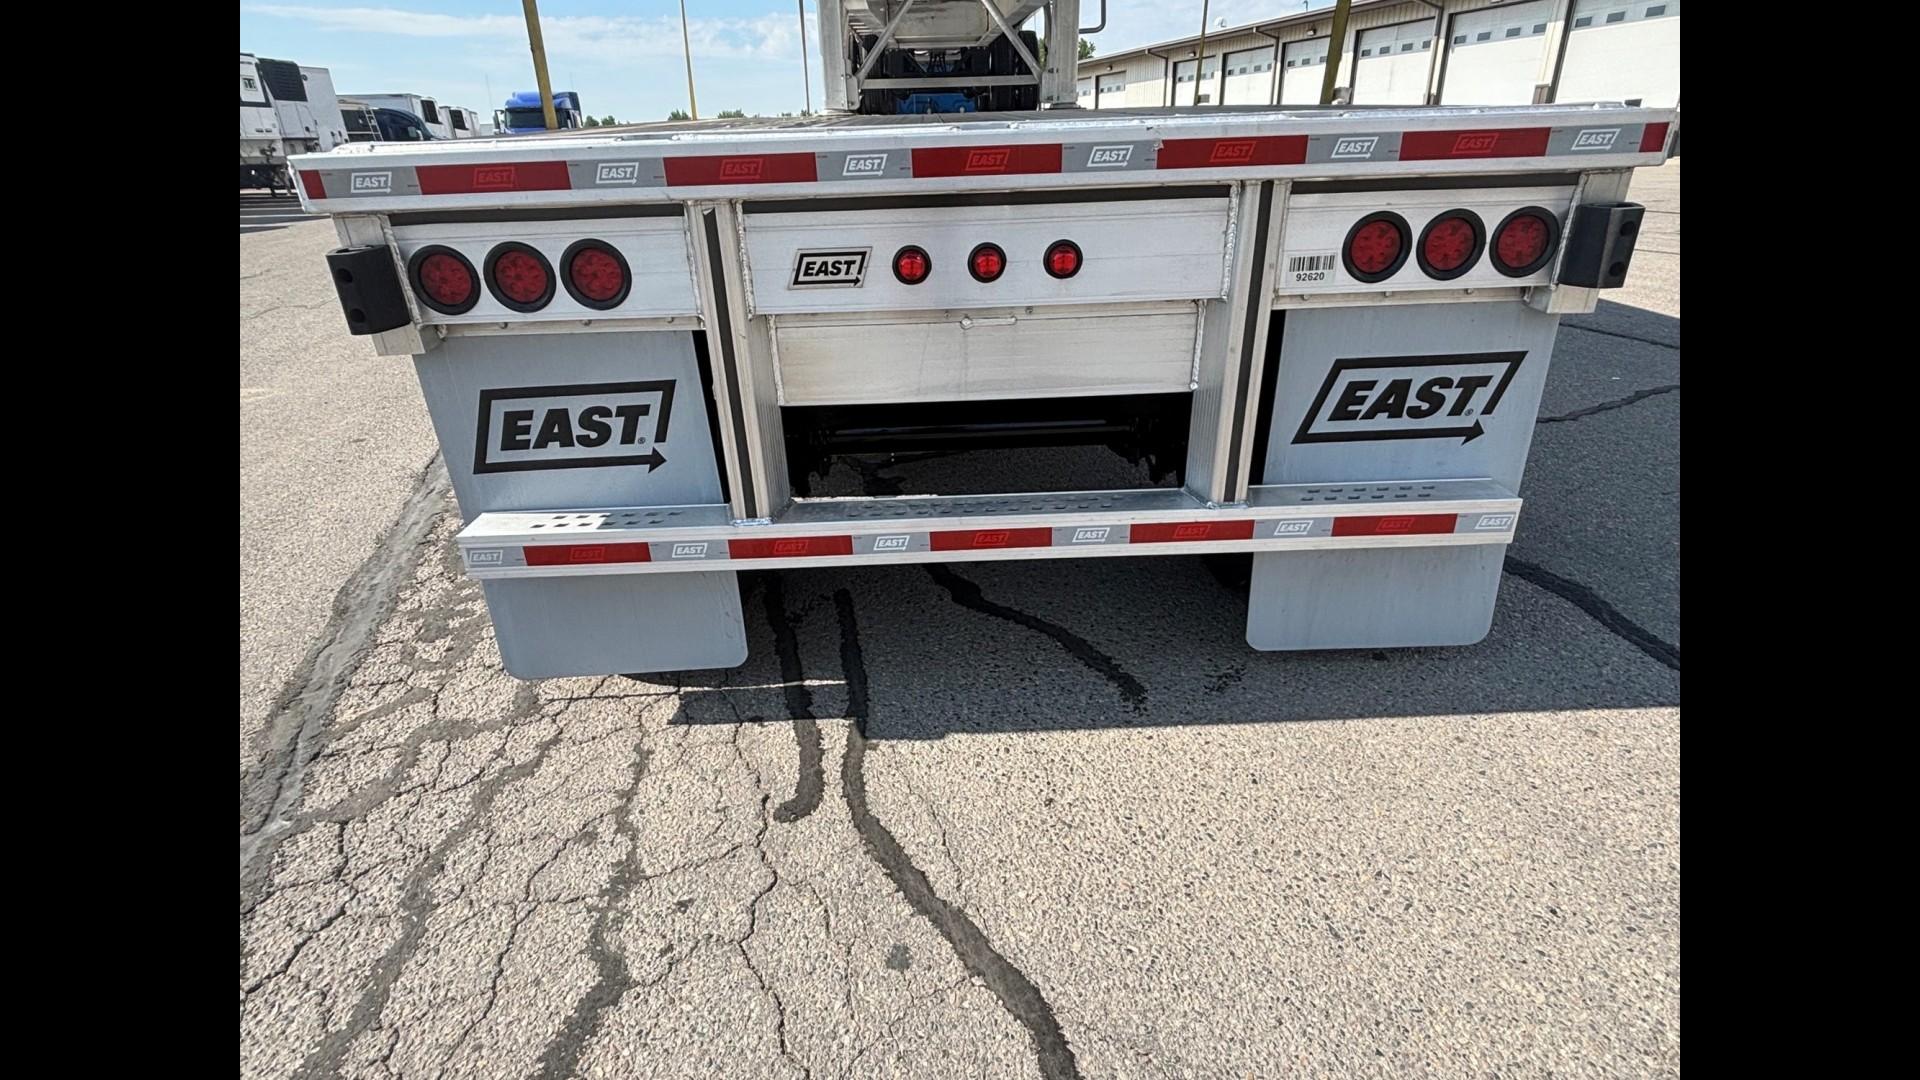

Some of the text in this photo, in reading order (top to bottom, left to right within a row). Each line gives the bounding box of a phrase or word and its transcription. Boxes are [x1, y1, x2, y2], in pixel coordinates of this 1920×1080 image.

[1459, 137, 1491, 149] EAST
[1579, 134, 1611, 144] EAST
[1217, 146, 1249, 158] EAST
[1338, 142, 1370, 153] EAST
[972, 154, 1004, 165] EAST
[1094, 150, 1125, 162] EAST
[726, 163, 757, 175] EAST
[849, 159, 881, 170] EAST
[479, 170, 511, 185] EAST
[602, 168, 632, 178] EAST
[355, 176, 388, 188] EAST
[804, 260, 853, 277] EAST
[1296, 272, 1325, 281] 92620
[1328, 376, 1493, 421] EAST
[500, 404, 650, 451] EAST
[1481, 518, 1507, 526] EAST
[1280, 524, 1307, 532] EAST
[1079, 531, 1104, 539] EAST
[879, 539, 904, 547] EAST
[678, 546, 704, 554] EAST
[473, 552, 499, 561] EAST
